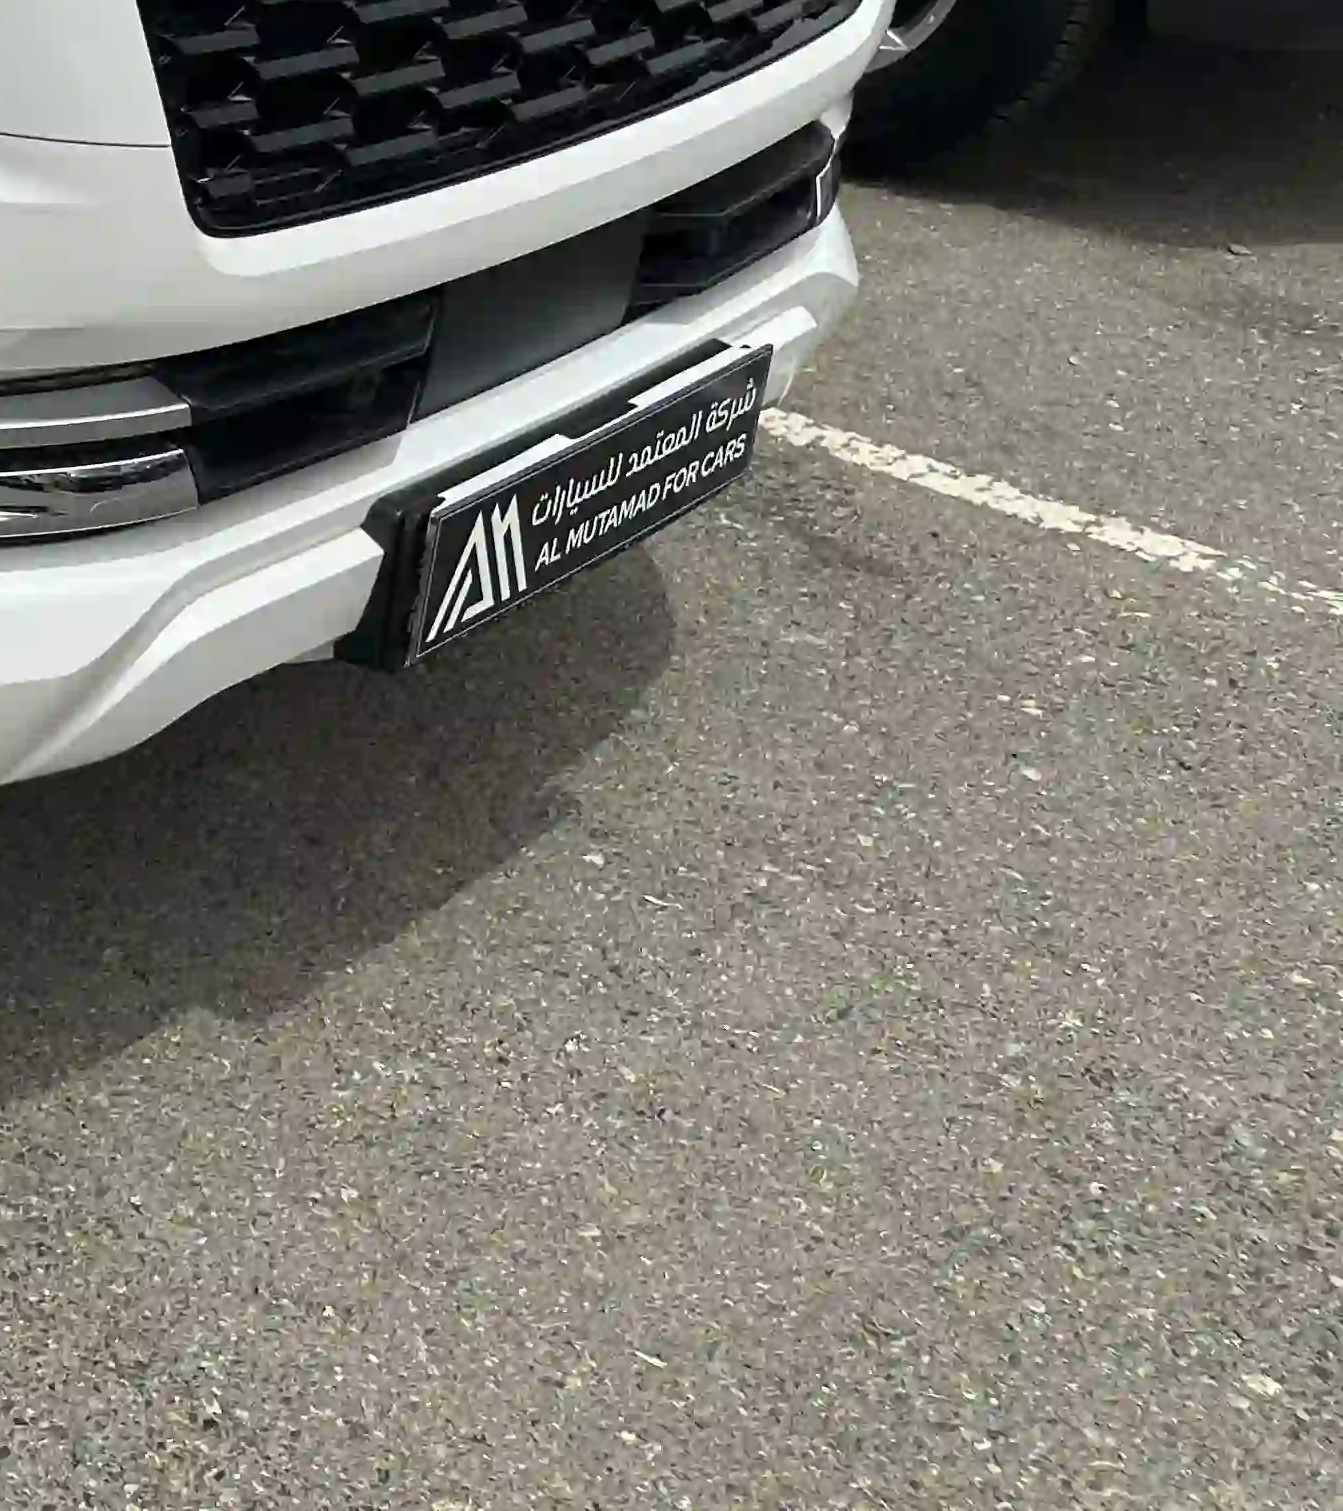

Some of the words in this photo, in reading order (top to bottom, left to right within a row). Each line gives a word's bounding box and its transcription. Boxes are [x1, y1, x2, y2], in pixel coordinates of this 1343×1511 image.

[706, 377, 757, 433] شركة
[625, 410, 703, 478] المعتمد
[531, 451, 624, 527] للسيارات
[534, 537, 562, 573] AL
[564, 482, 661, 555] MUTAMAD
[661, 460, 701, 501] FOR
[700, 433, 748, 478] CARS
